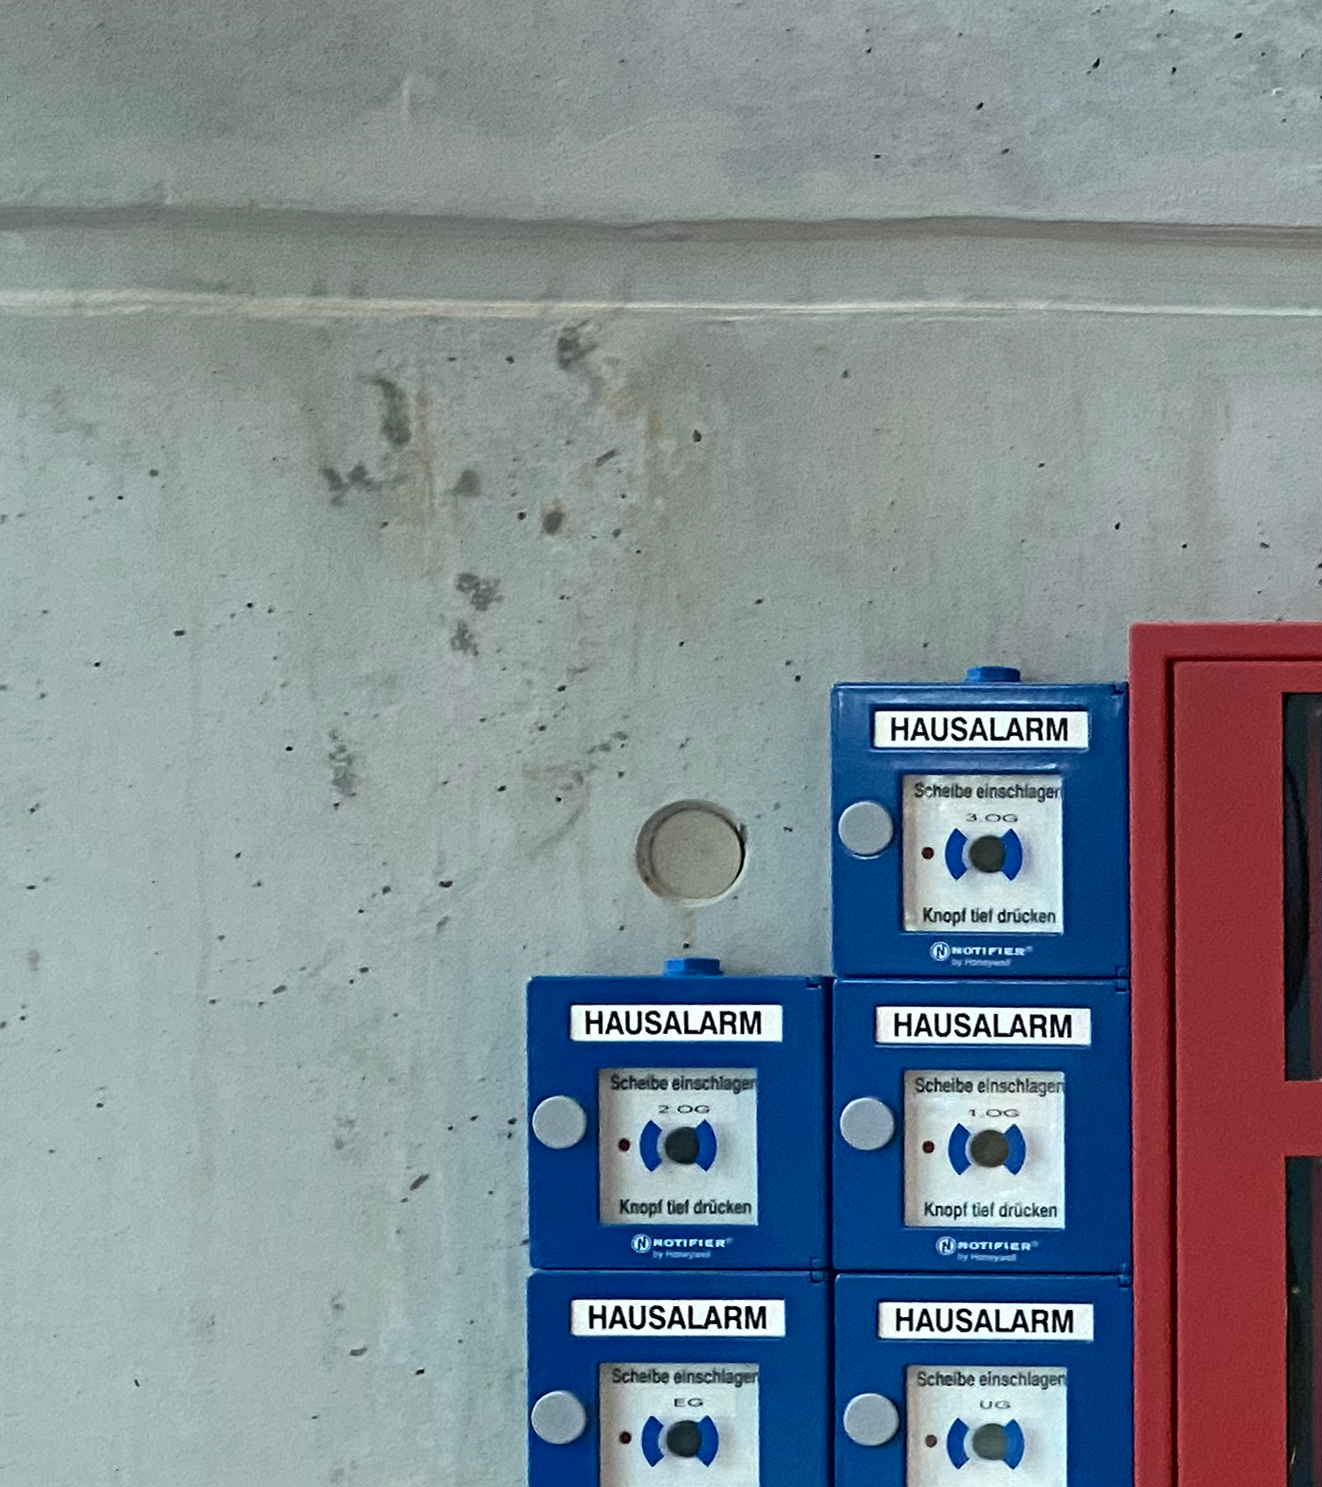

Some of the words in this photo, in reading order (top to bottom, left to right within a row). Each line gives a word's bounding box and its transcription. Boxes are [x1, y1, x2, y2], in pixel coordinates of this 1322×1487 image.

[890, 716, 1069, 742] HAUSALARM
[915, 781, 972, 800] Scheibe
[923, 906, 967, 927] Knopf
[971, 907, 993, 923] tief
[997, 907, 1056, 924] drücken
[584, 1010, 763, 1036] HAUSALARM
[893, 1012, 1073, 1039] HAUSALARM
[610, 1075, 669, 1091] Scheibe
[915, 1077, 973, 1094] Scheibe
[619, 1199, 663, 1218] Knopf
[667, 1199, 690, 1215] tief
[693, 1199, 752, 1215] drücken
[924, 1201, 968, 1220] Knopf
[972, 1201, 995, 1217] tief
[999, 1201, 1058, 1218] drücken
[588, 1305, 768, 1330] HAUSALARM
[895, 1307, 1075, 1334] HAUSALARM
[612, 1368, 669, 1384] Scheibe
[917, 1371, 975, 1387] Scheibe
[673, 1397, 703, 1408] EG
[979, 1399, 1011, 1410] UG
